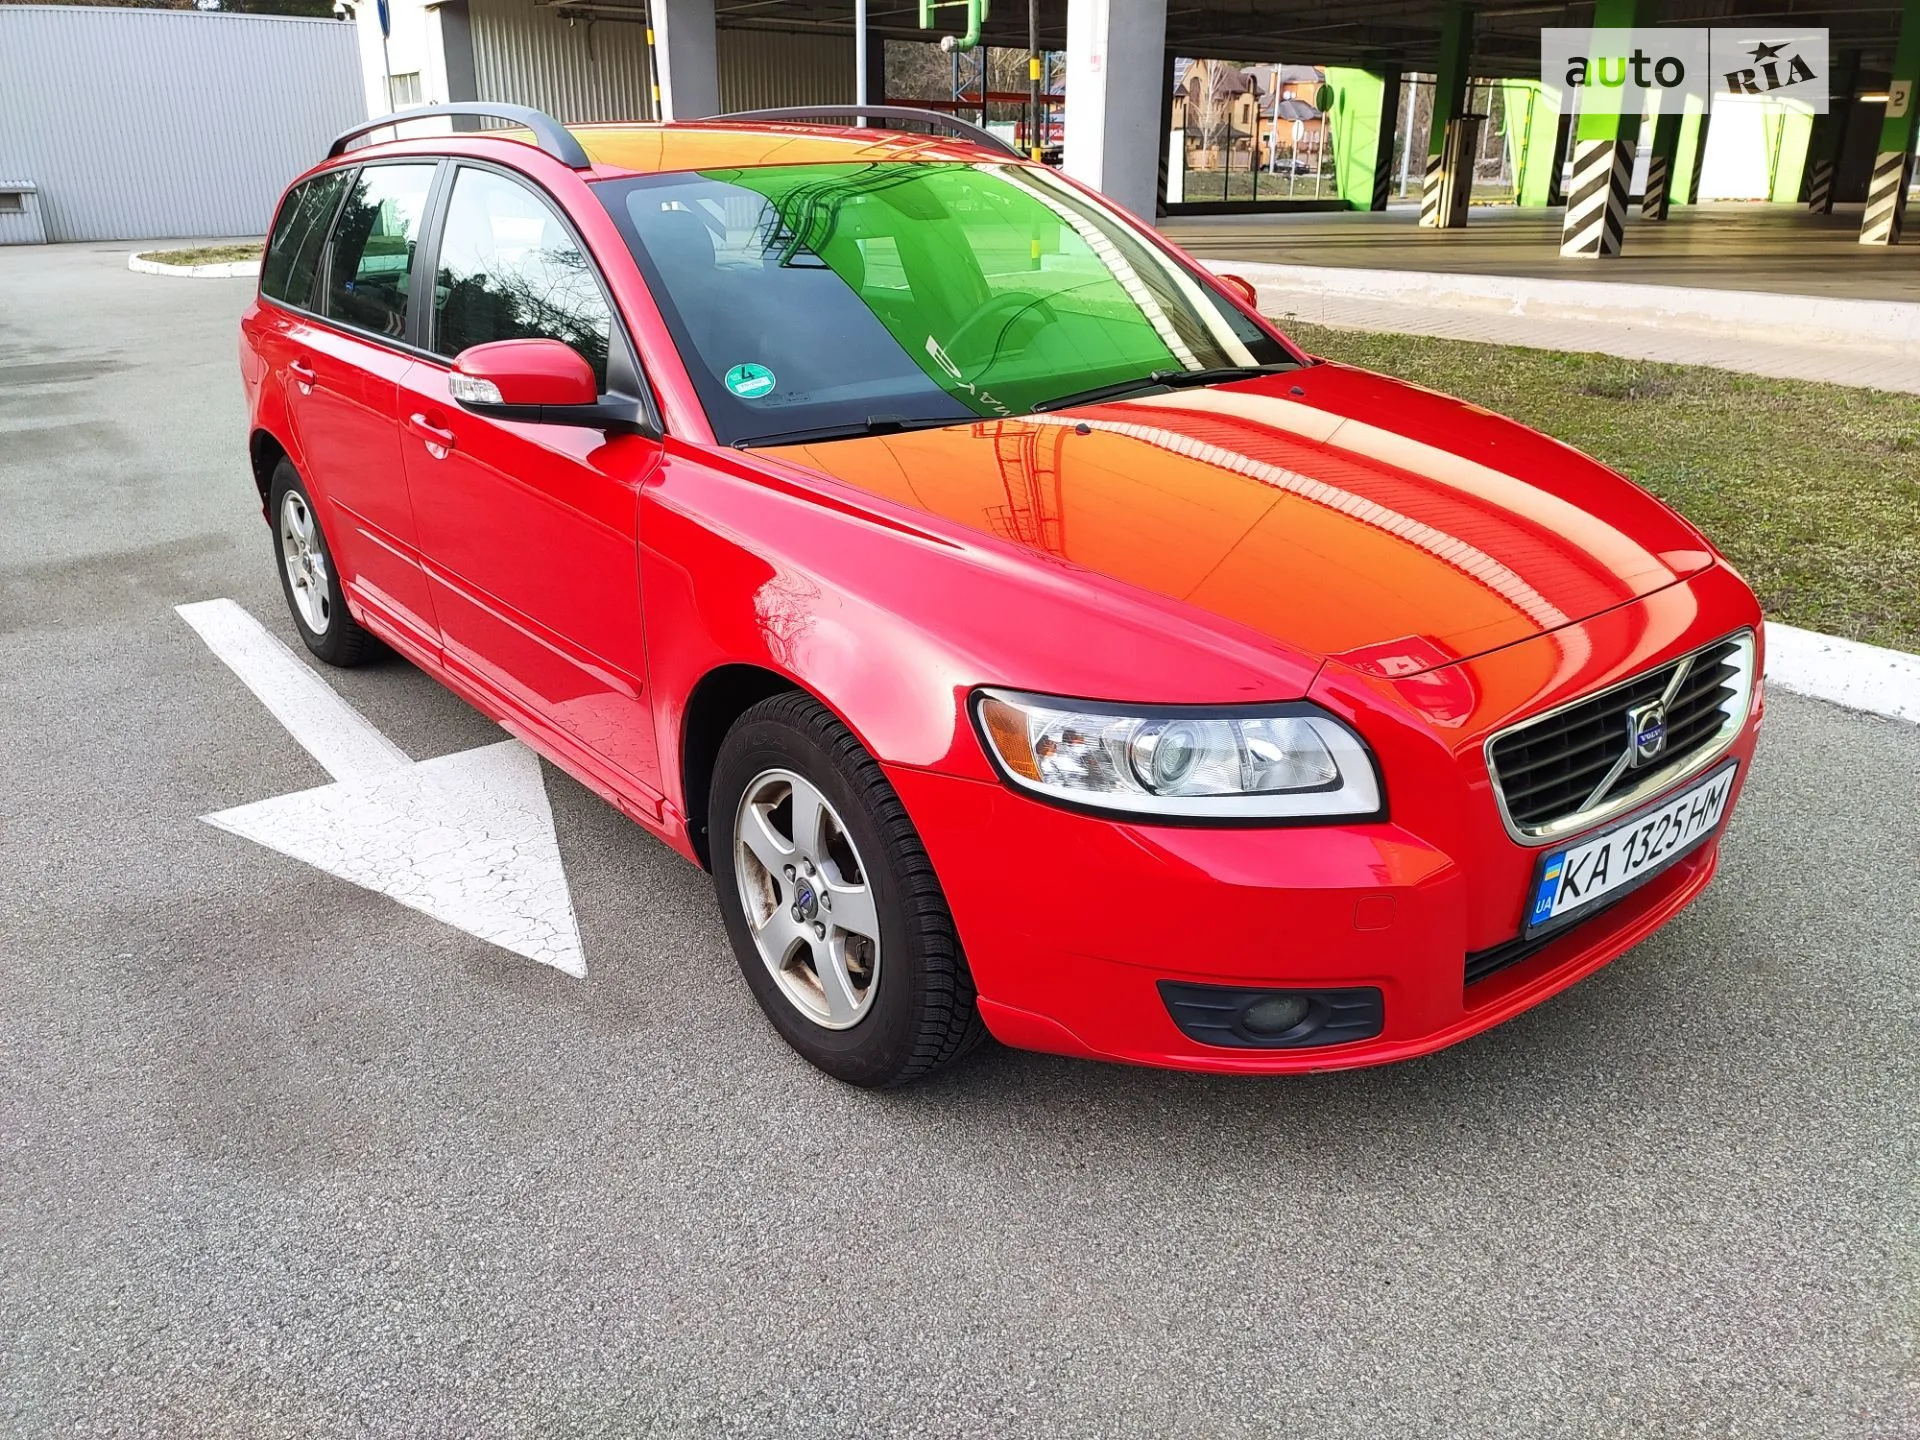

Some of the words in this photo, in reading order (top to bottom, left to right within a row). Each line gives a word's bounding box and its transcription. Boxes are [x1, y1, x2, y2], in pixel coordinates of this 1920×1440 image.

[1893, 90, 1905, 107] 2
[741, 366, 755, 380] 4
[1557, 843, 1611, 905] KA
[1623, 802, 1688, 874] 1325
[1684, 776, 1729, 839] HM
[1536, 896, 1552, 914] UA
